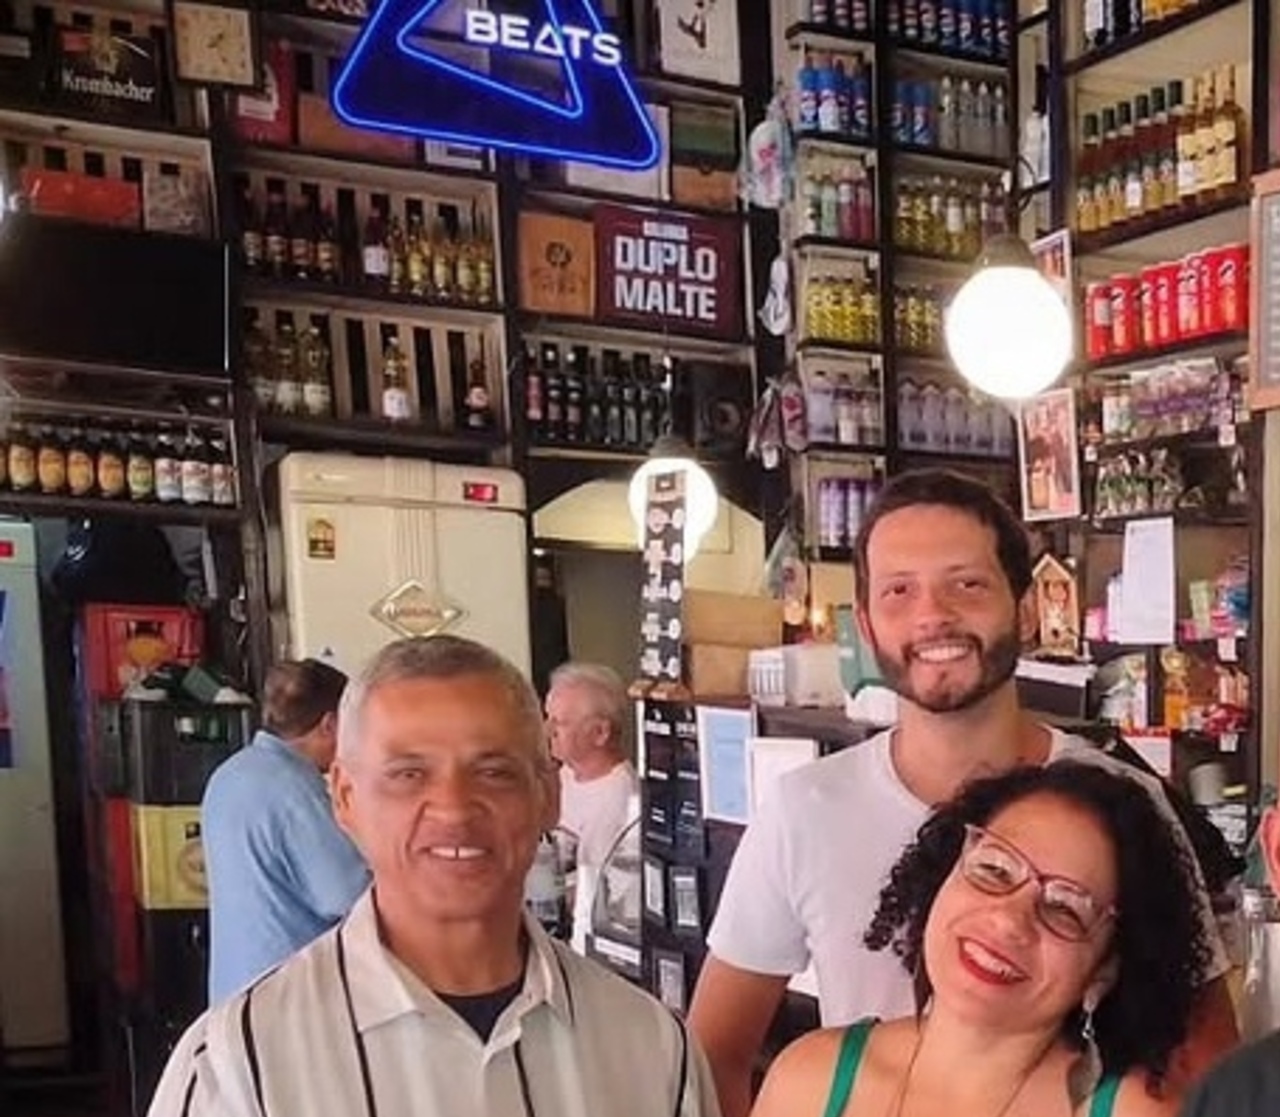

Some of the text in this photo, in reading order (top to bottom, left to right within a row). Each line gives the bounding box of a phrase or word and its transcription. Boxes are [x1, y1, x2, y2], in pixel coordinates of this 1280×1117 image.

[465, 9, 622, 66] BEATS
[62, 68, 155, 102] Krombacher
[614, 235, 718, 282] DUPLO
[614, 275, 717, 321] MALTE
